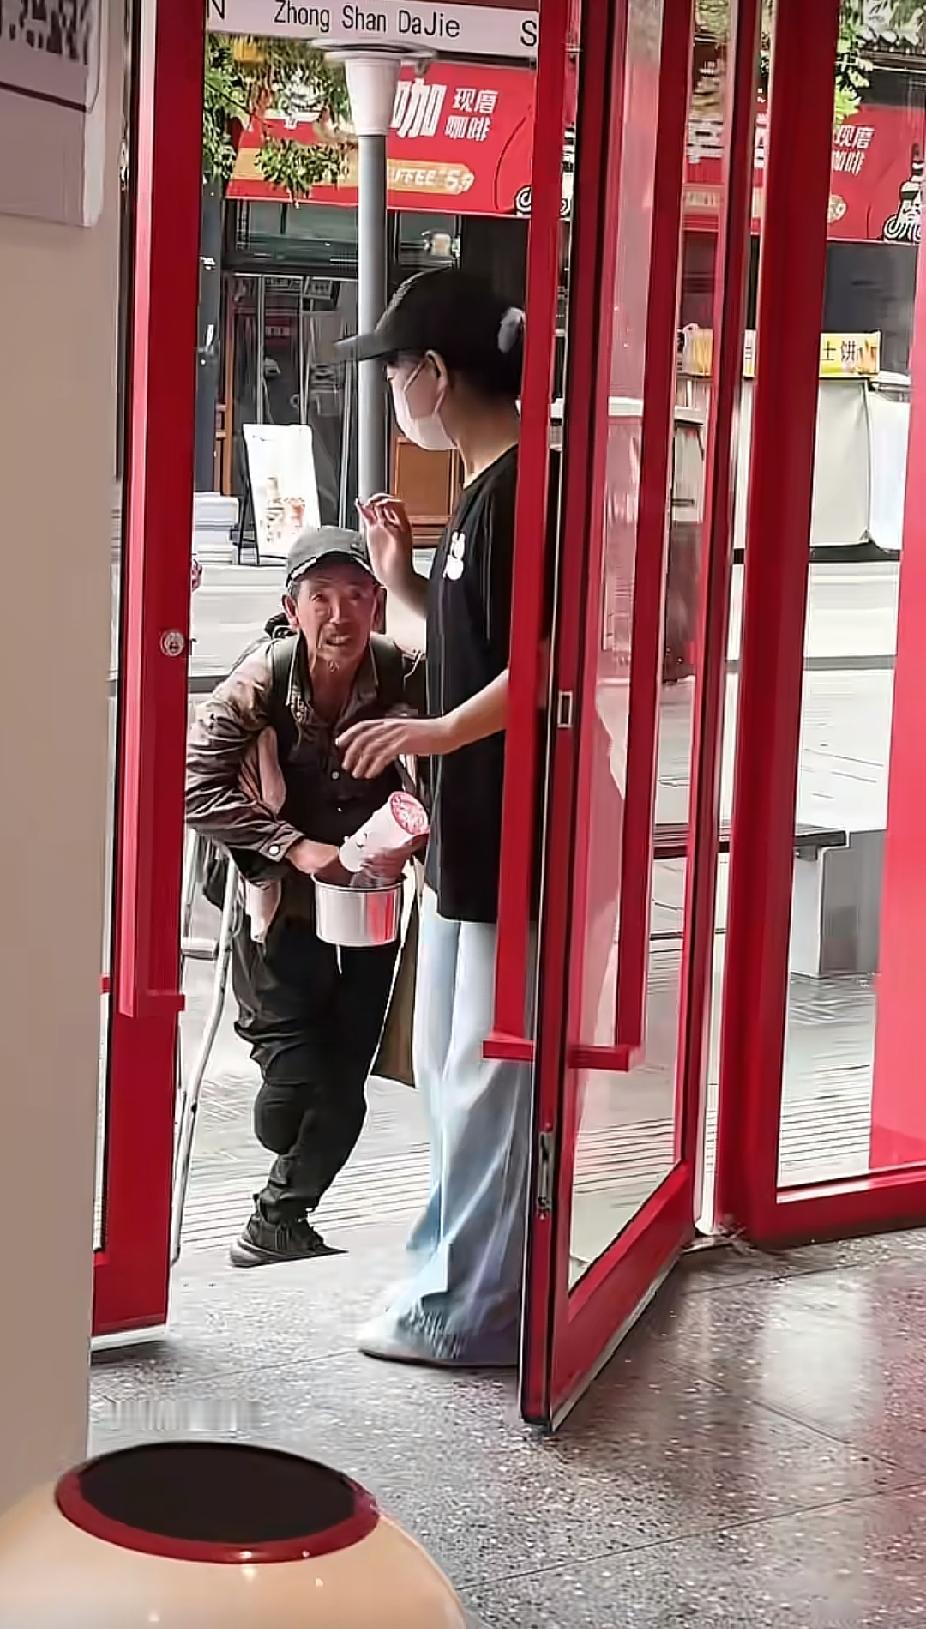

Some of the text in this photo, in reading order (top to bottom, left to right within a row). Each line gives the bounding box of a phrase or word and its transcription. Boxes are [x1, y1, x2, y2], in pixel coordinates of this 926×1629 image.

[273, 0, 460, 37] Zhong Shan DaJie
[520, 20, 537, 47] S
[444, 115, 491, 141] 咖啡
